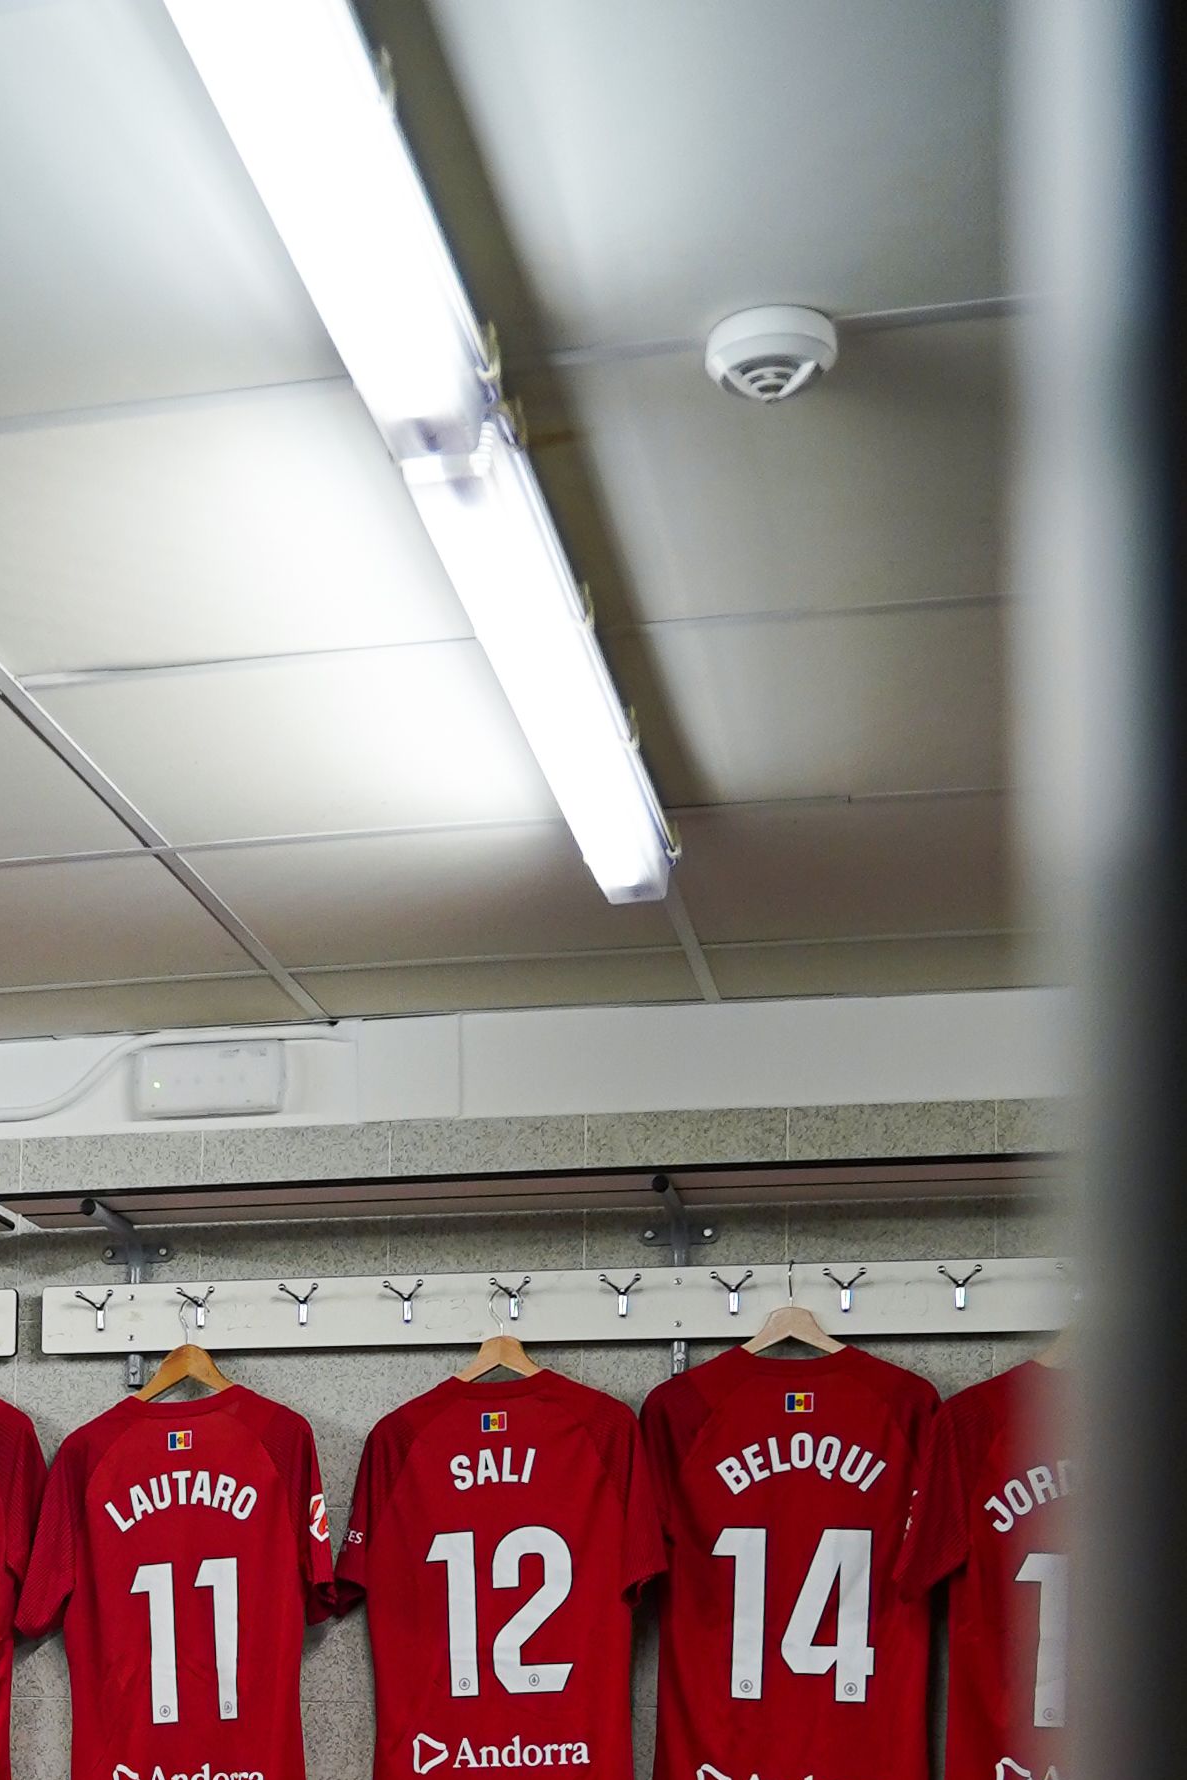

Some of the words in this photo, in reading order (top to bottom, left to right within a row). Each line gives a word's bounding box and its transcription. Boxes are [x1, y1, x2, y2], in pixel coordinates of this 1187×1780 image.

[450, 1447, 535, 1490] SALI
[716, 1433, 886, 1494] BELOQUI
[105, 1471, 257, 1532] LAUTARO
[131, 1558, 237, 1724] 11
[426, 1526, 573, 1696] 12
[712, 1528, 874, 1702] 14
[453, 1735, 590, 1768] Andorra
